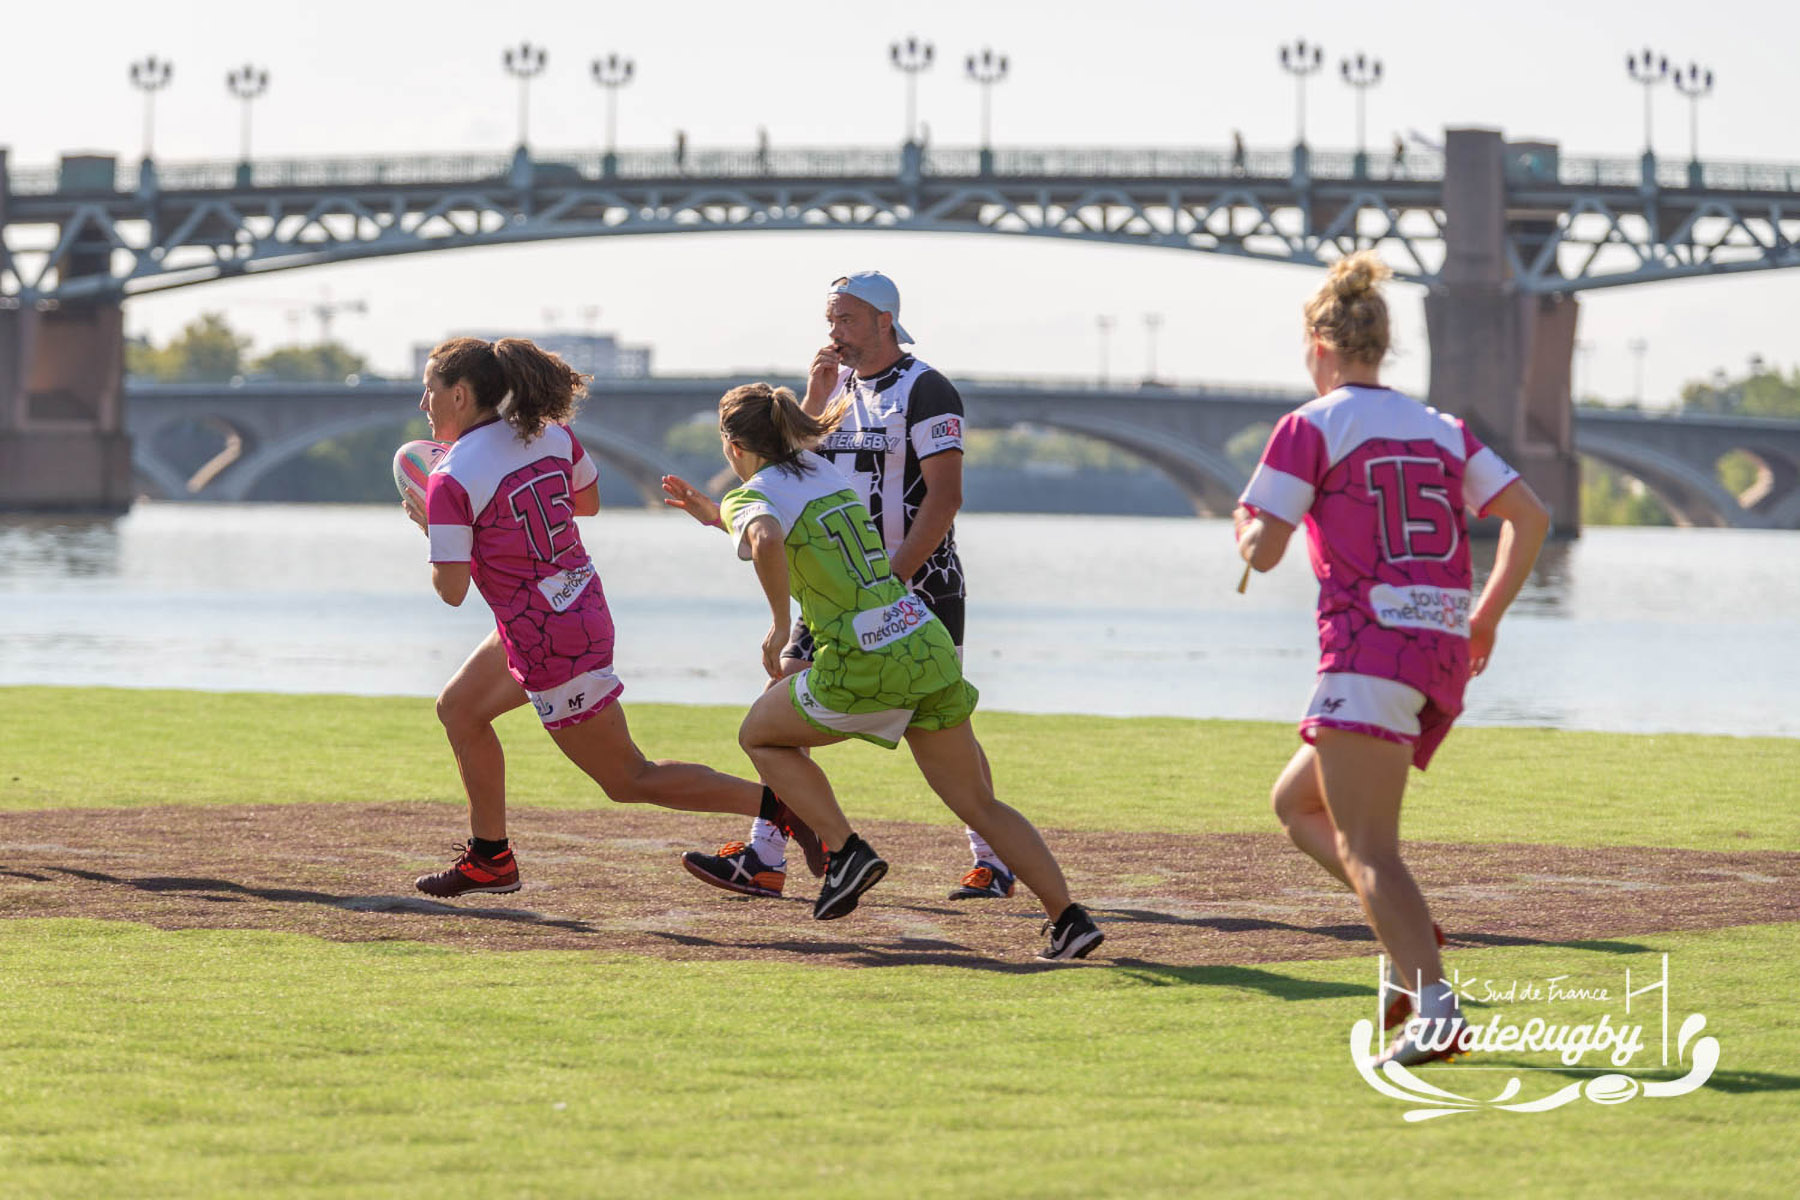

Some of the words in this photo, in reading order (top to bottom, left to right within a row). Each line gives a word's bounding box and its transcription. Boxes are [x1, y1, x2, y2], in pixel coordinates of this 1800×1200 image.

[508, 470, 577, 563] 15
[816, 501, 894, 589] 15
[1364, 456, 1458, 562] 15
